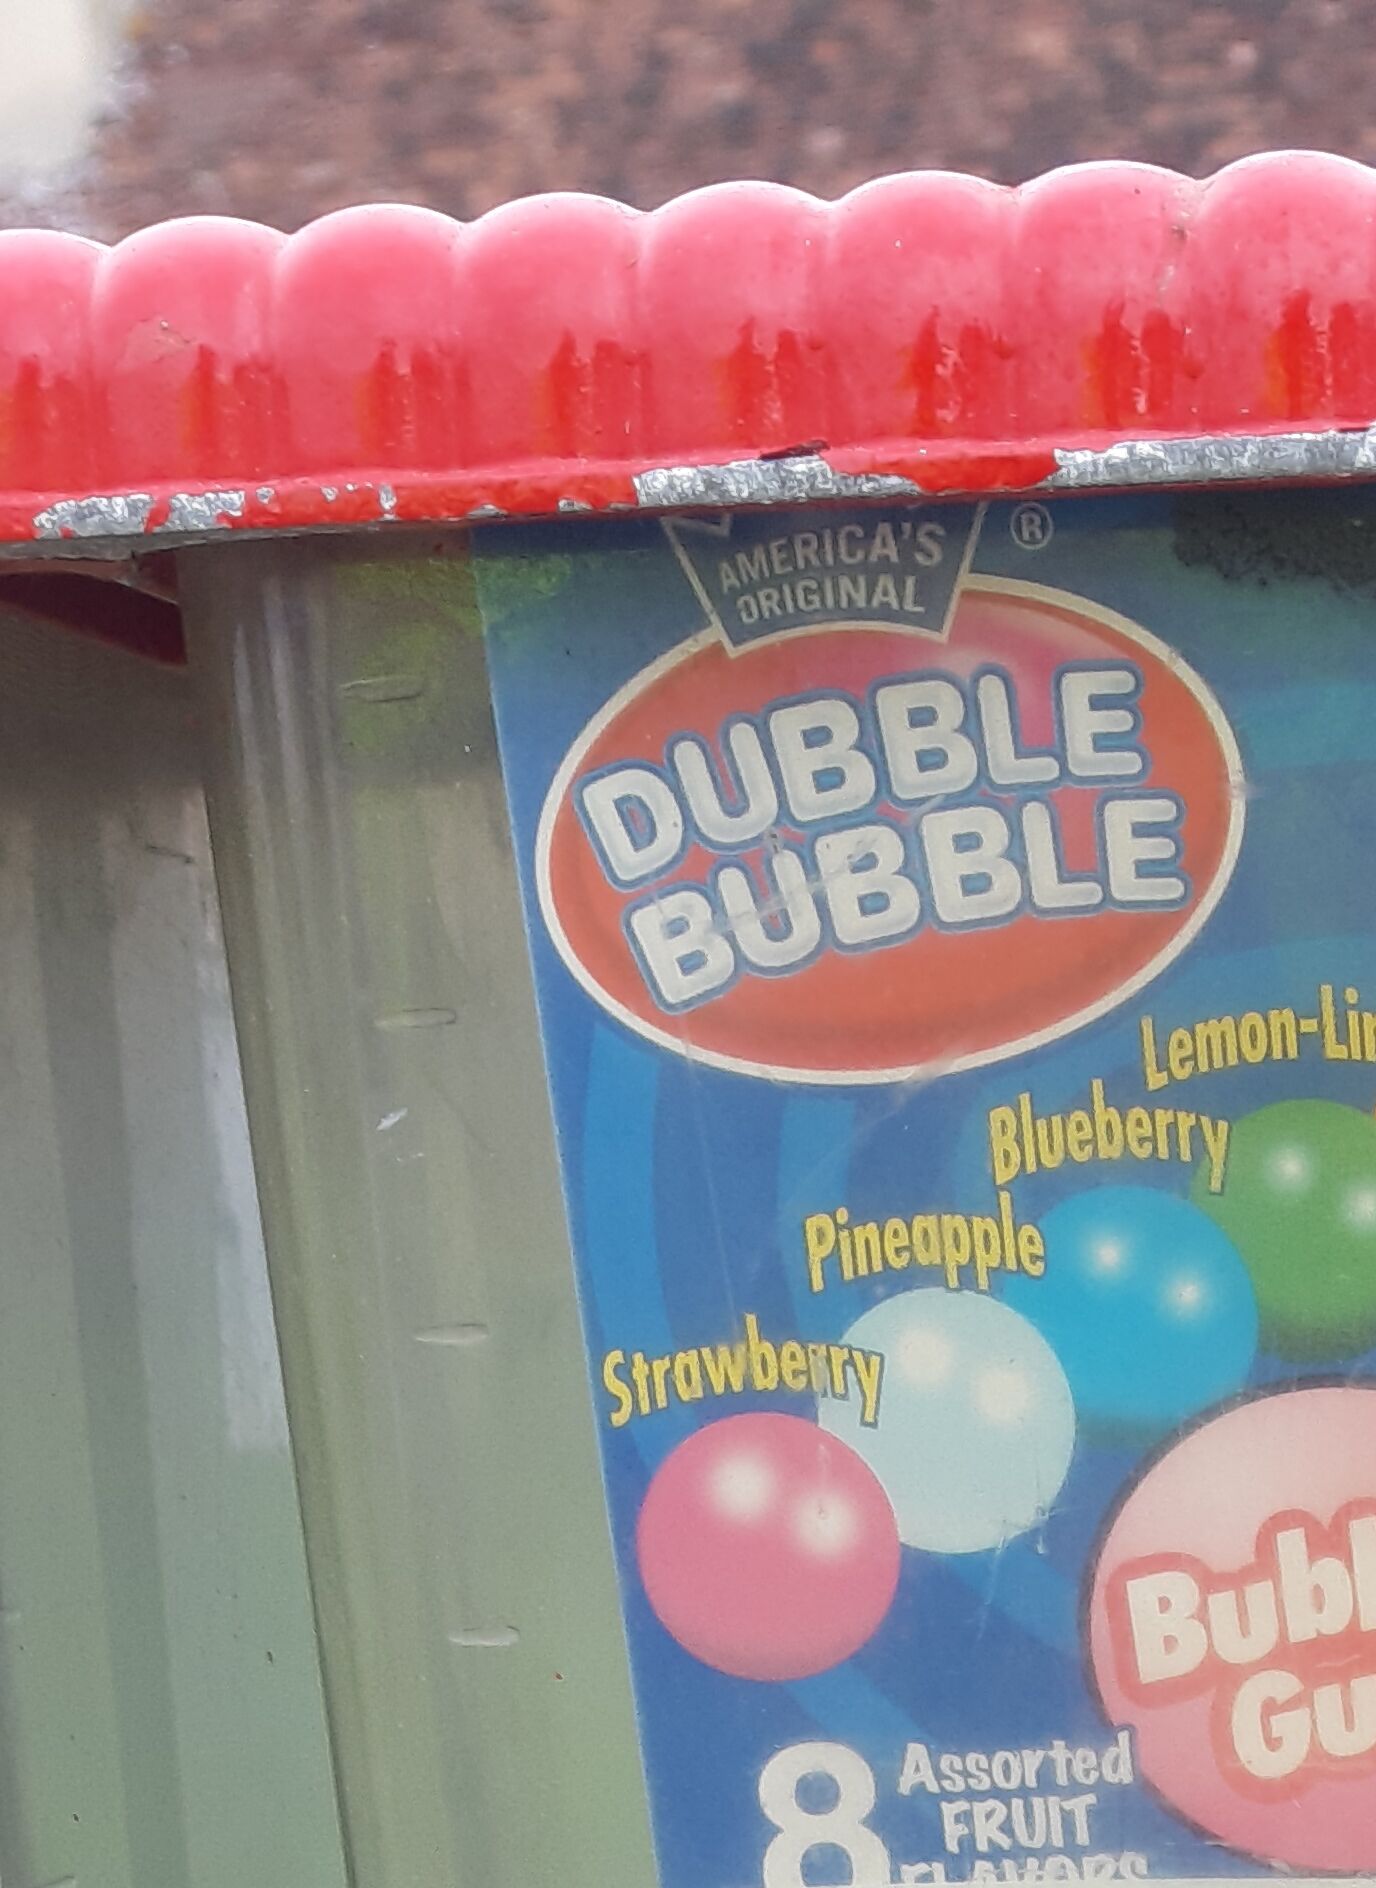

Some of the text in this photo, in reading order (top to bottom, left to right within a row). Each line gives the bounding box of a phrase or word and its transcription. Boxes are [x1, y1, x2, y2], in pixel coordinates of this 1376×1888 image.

[717, 522, 945, 593] AMERICA'S
[738, 573, 925, 624] ORIGINAL
[582, 669, 1143, 882] DUBBLE
[632, 797, 1186, 1004] BUBBLE
[990, 1079, 1229, 1194] Blueberry
[805, 1191, 1045, 1291] Pineapple
[603, 1315, 884, 1428] Strawberry
[897, 1727, 1133, 1795] Assorted
[942, 1793, 1097, 1853] FRUIT
